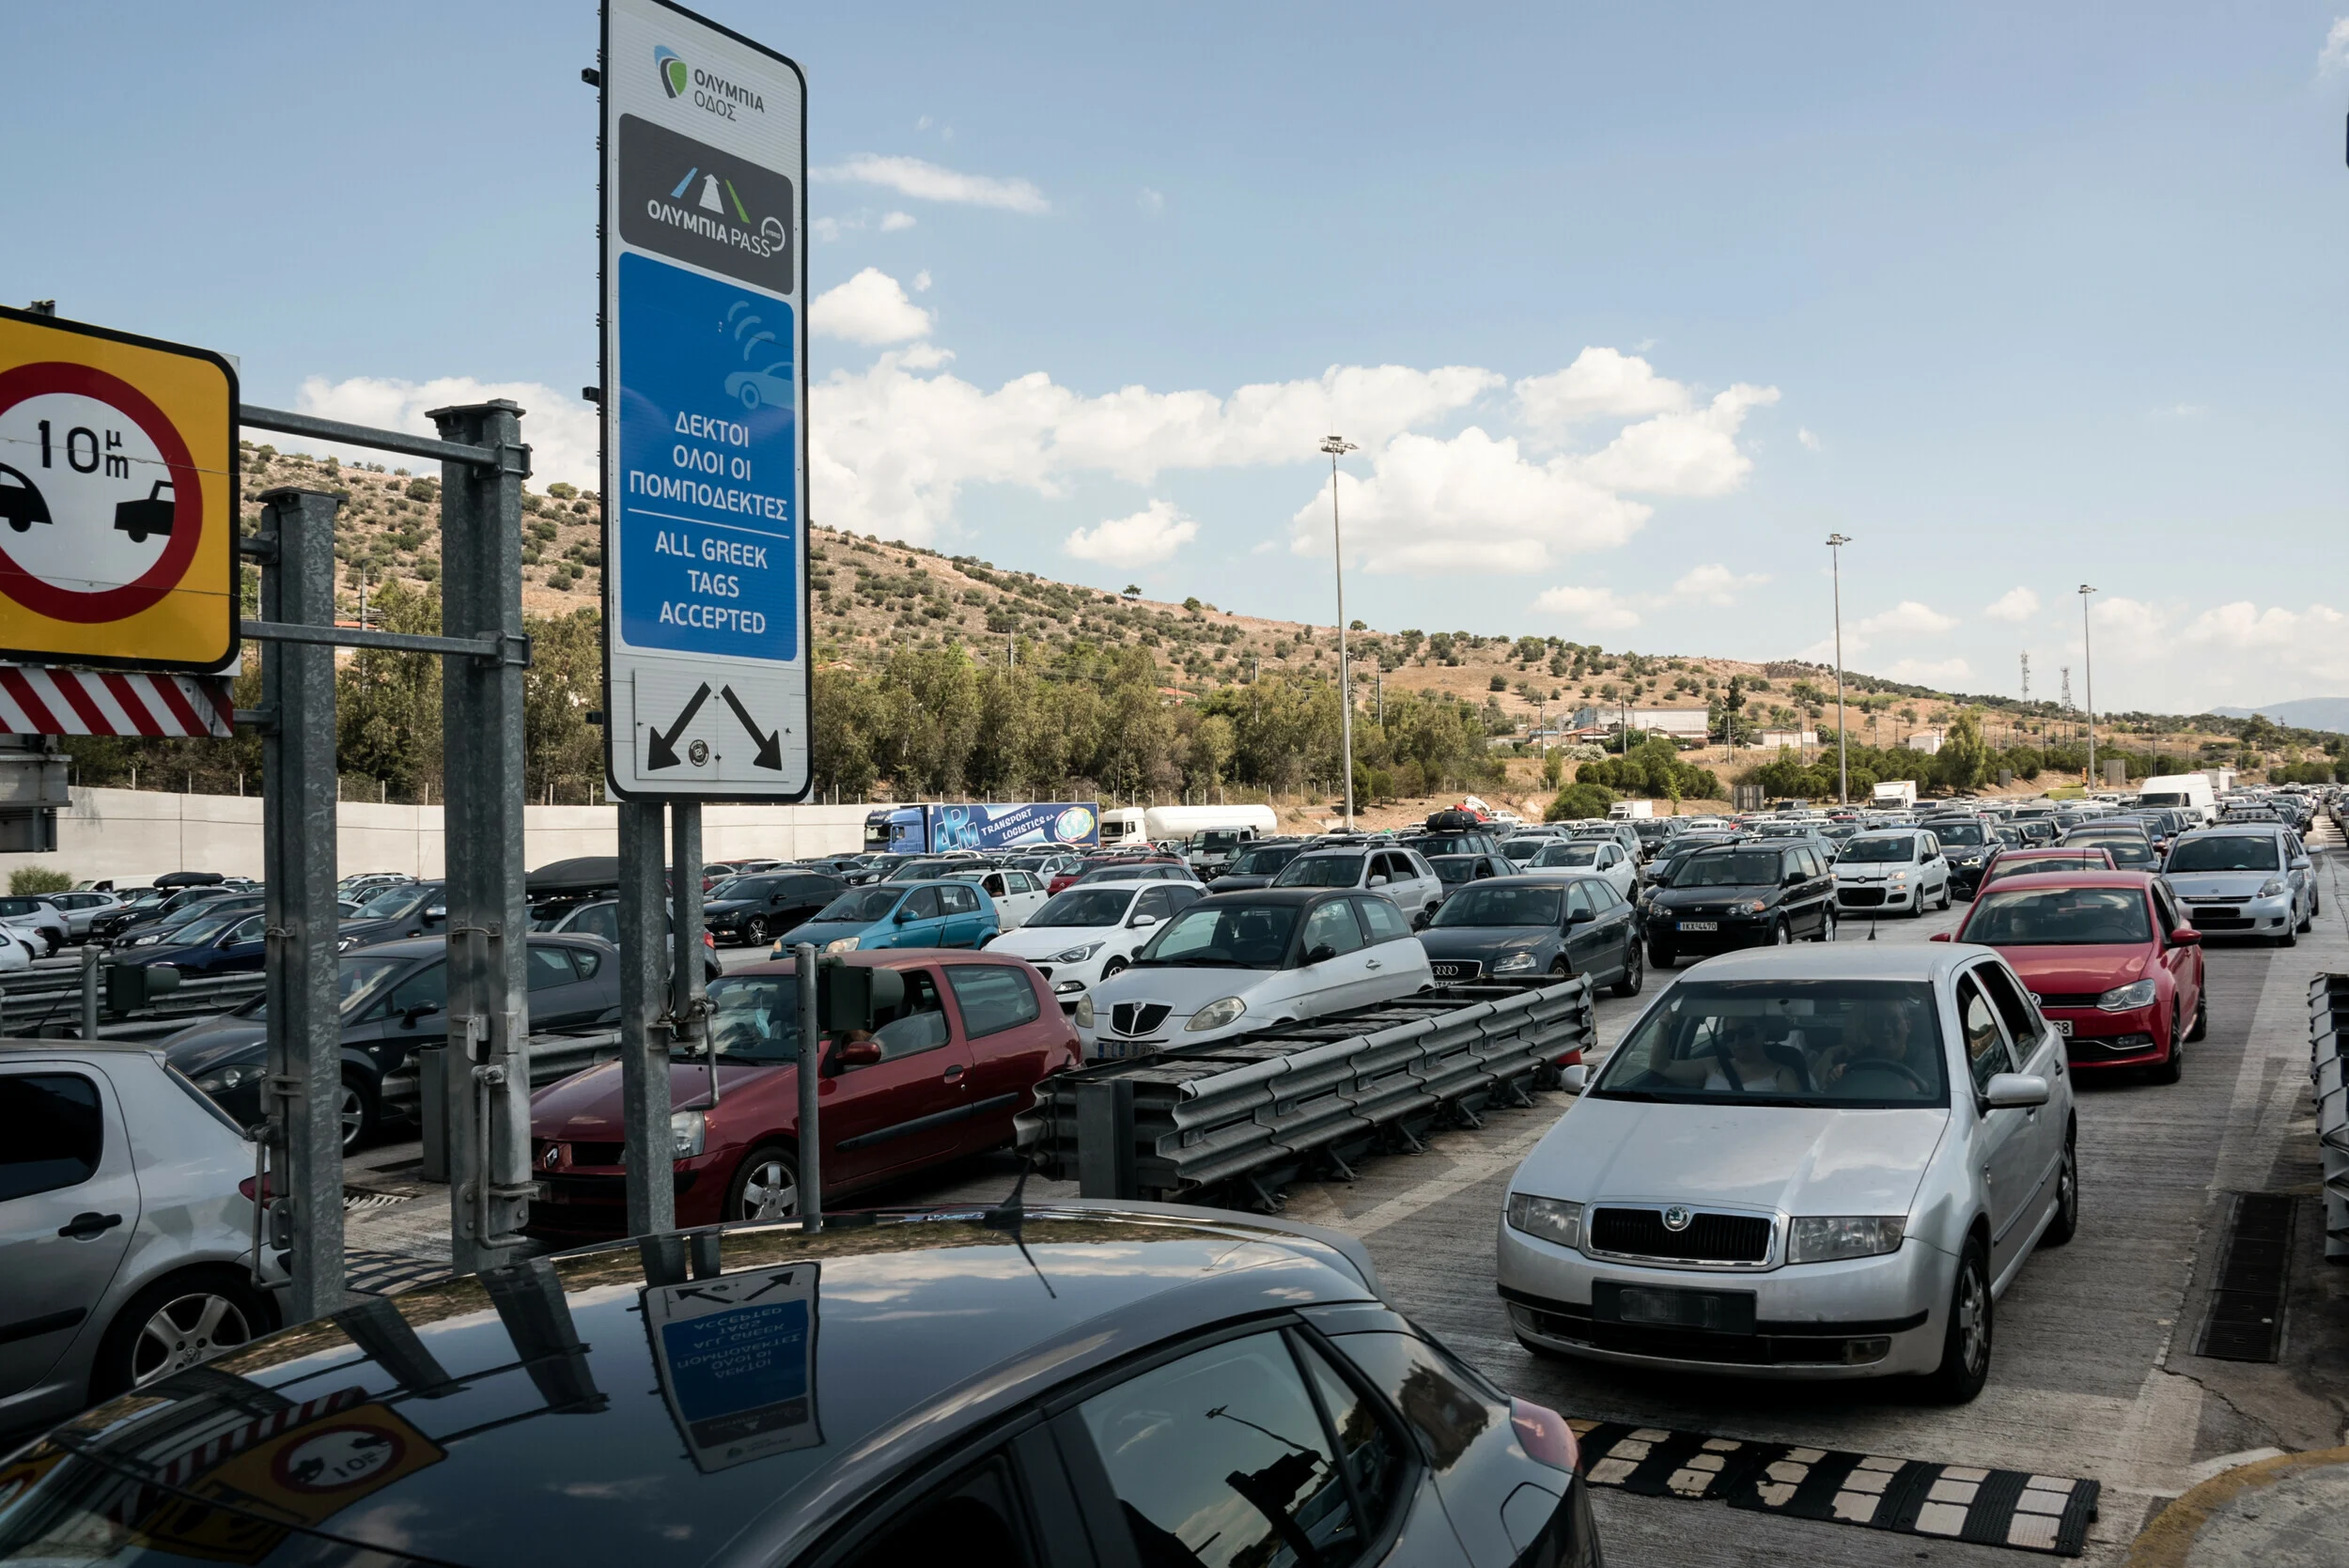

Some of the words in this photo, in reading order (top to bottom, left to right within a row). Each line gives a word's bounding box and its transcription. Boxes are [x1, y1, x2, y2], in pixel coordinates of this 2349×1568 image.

[694, 69, 765, 113] ΟΛΥΜΠΙΑ
[694, 90, 737, 121] ΟΔΟΣ
[647, 199, 728, 243] ΟΛΥΜΠΙΑ
[731, 227, 770, 257] PASS
[39, 420, 100, 474] 10
[675, 411, 749, 447] ΔΕΚΤΟΙ
[673, 444, 723, 475] ΟΛΟΙ
[731, 458, 751, 481] ΟΙ
[630, 470, 787, 520] ΠΟΜΠΟΔΕΚΤΕΣ
[655, 531, 695, 558] ALL
[702, 538, 768, 569] GREEK
[687, 569, 739, 598] TAGS
[660, 601, 766, 634] ACCEPTED
[981, 808, 1033, 836] TRANSPORT
[1003, 816, 1045, 841] LOGISTICS
